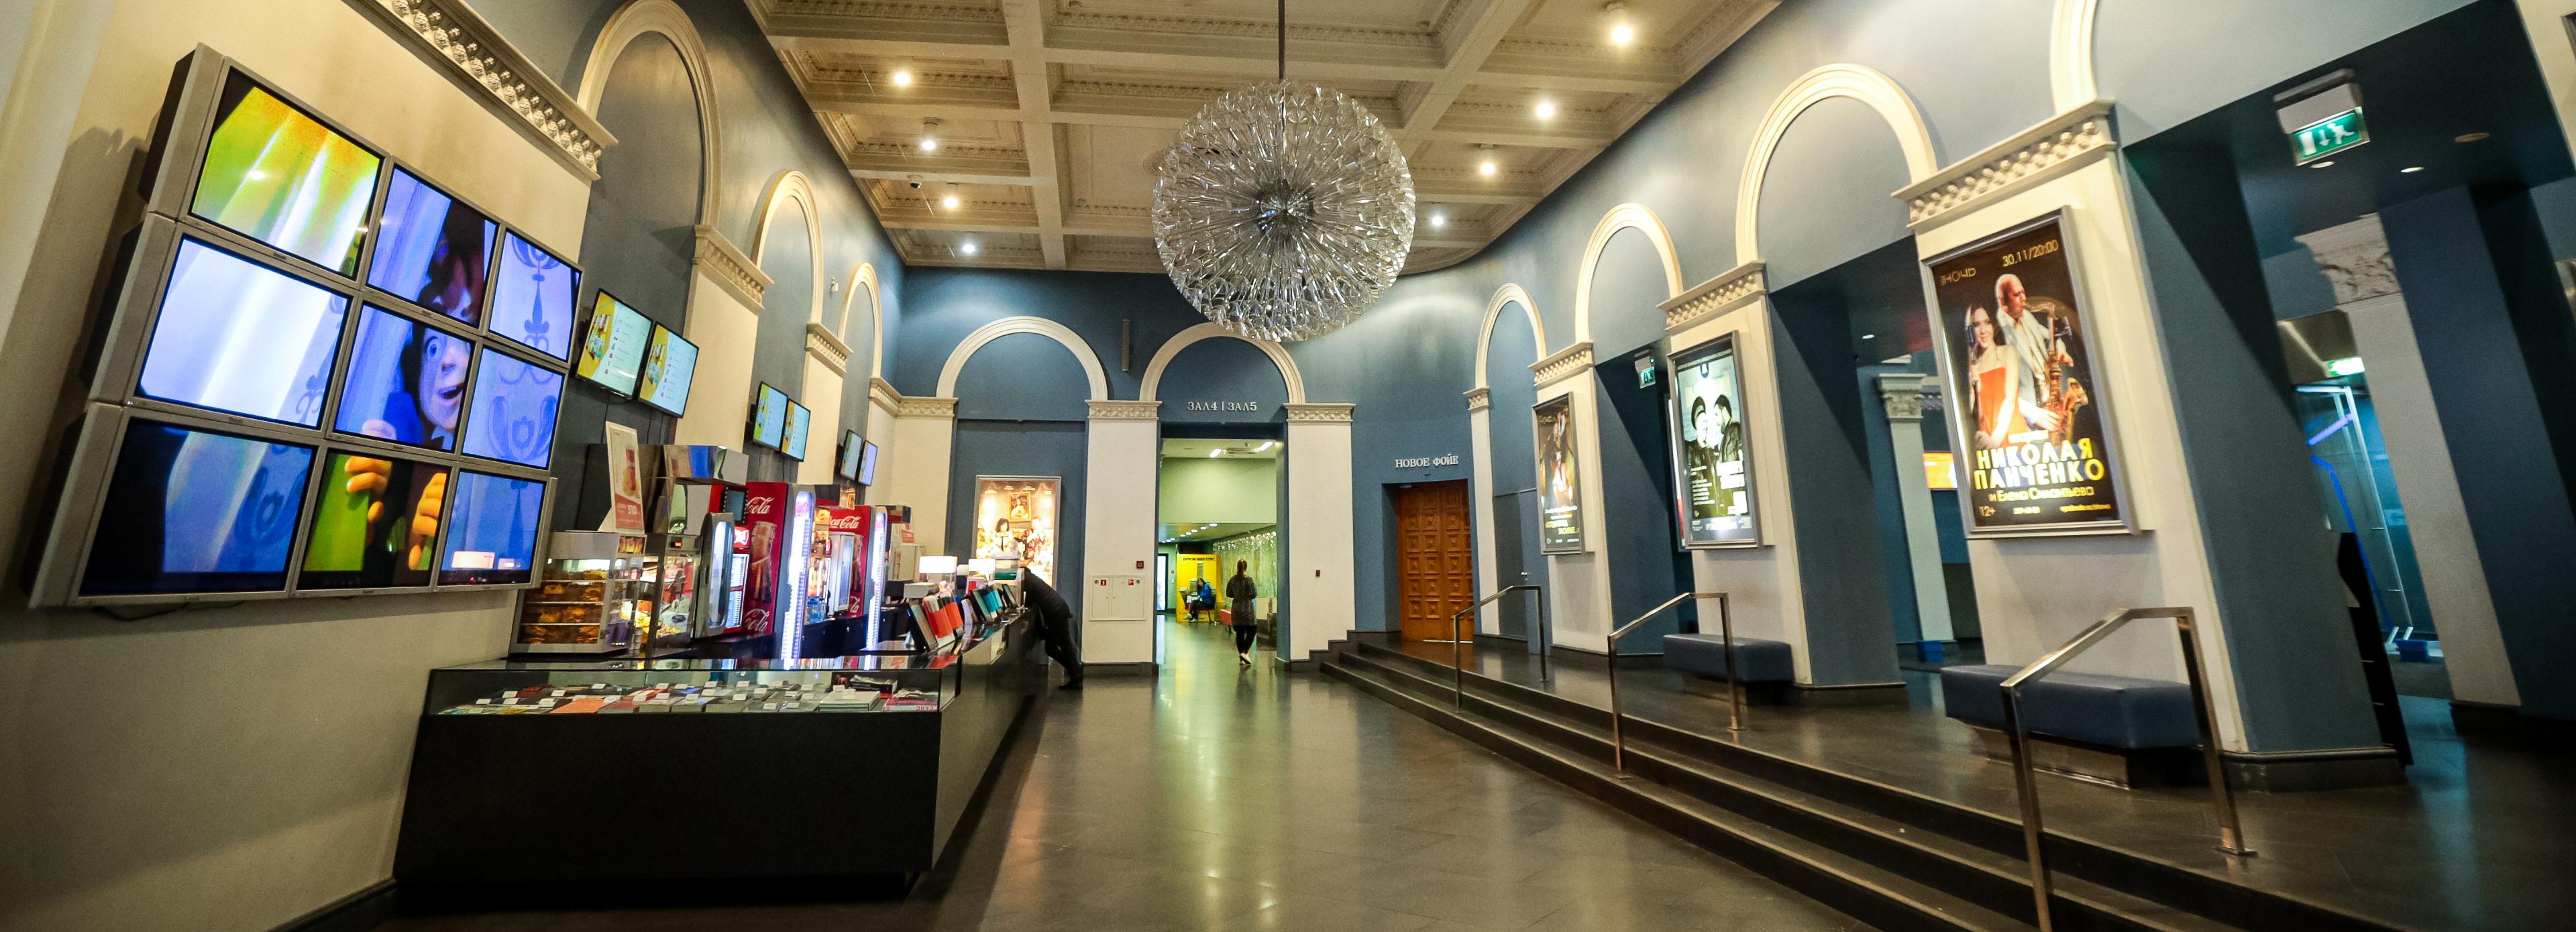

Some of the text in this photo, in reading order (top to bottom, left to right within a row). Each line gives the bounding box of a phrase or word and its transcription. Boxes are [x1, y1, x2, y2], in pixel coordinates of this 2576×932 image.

[2002, 239, 2059, 267] 30.11/20:00
[1395, 453, 1459, 468] НОВОЕ ФОЙЕ
[1976, 437, 2094, 469] НИКОЛАЯ
[1973, 459, 2105, 490] ПАНЧЕНКО
[1979, 505, 1996, 517] 12+
